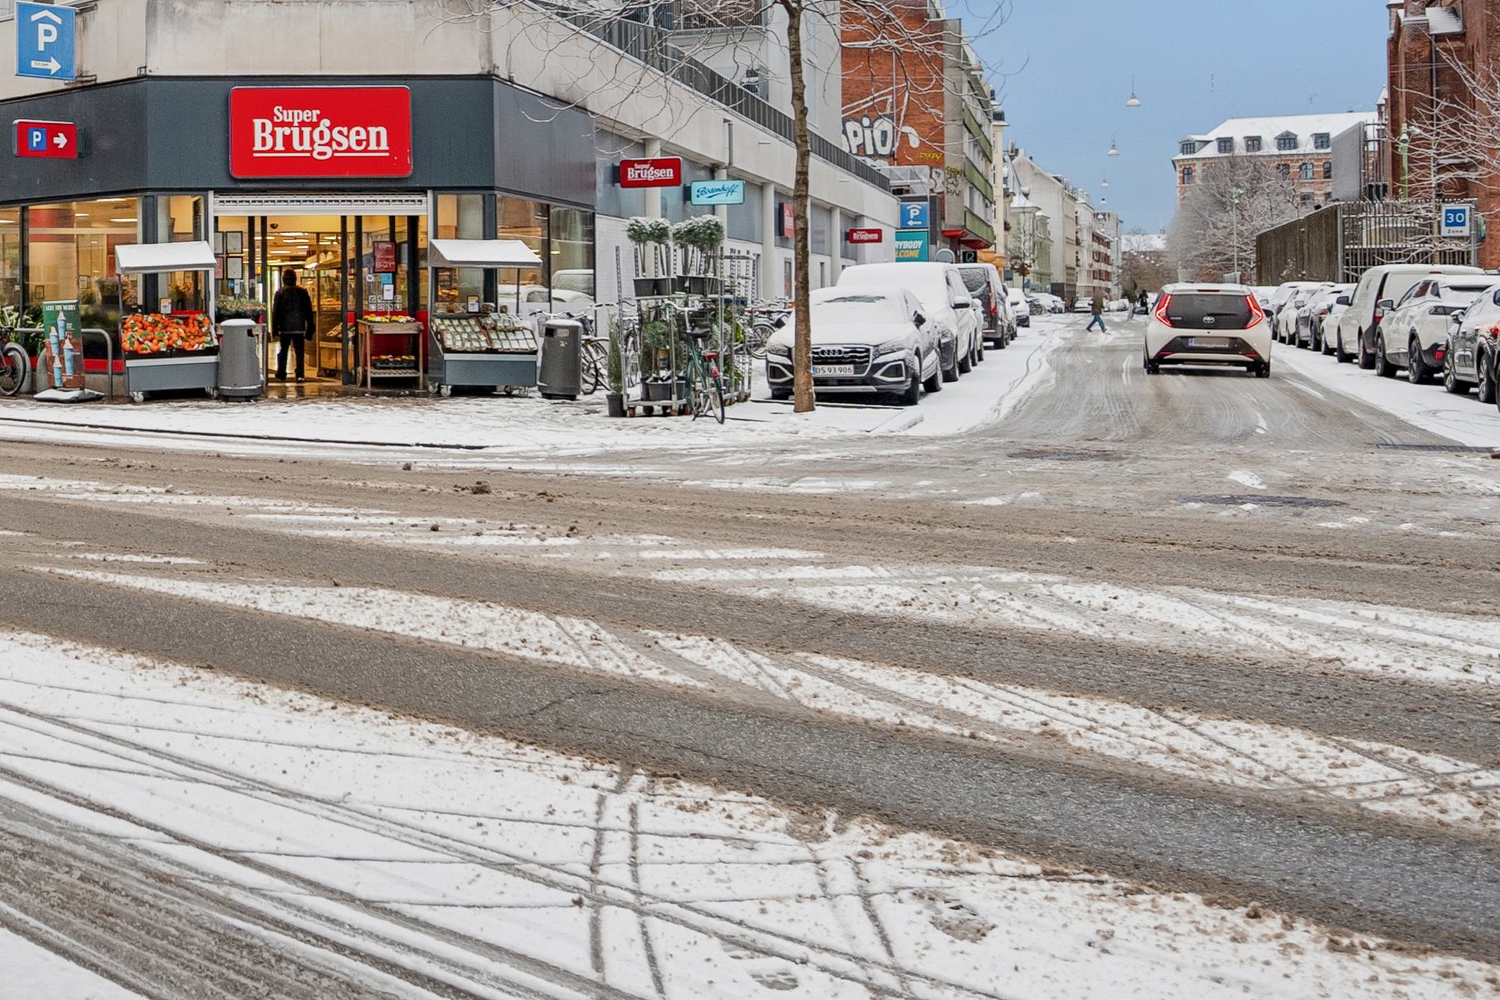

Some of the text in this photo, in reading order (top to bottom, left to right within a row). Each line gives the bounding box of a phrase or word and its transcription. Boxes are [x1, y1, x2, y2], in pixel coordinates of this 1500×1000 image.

[37, 23, 58, 51] P
[273, 105, 321, 126] Super
[32, 131, 42, 147] P
[252, 118, 390, 160] Brugsen
[627, 166, 674, 181] Brugsen
[910, 208, 920, 219] P
[1446, 212, 1465, 223] 30
